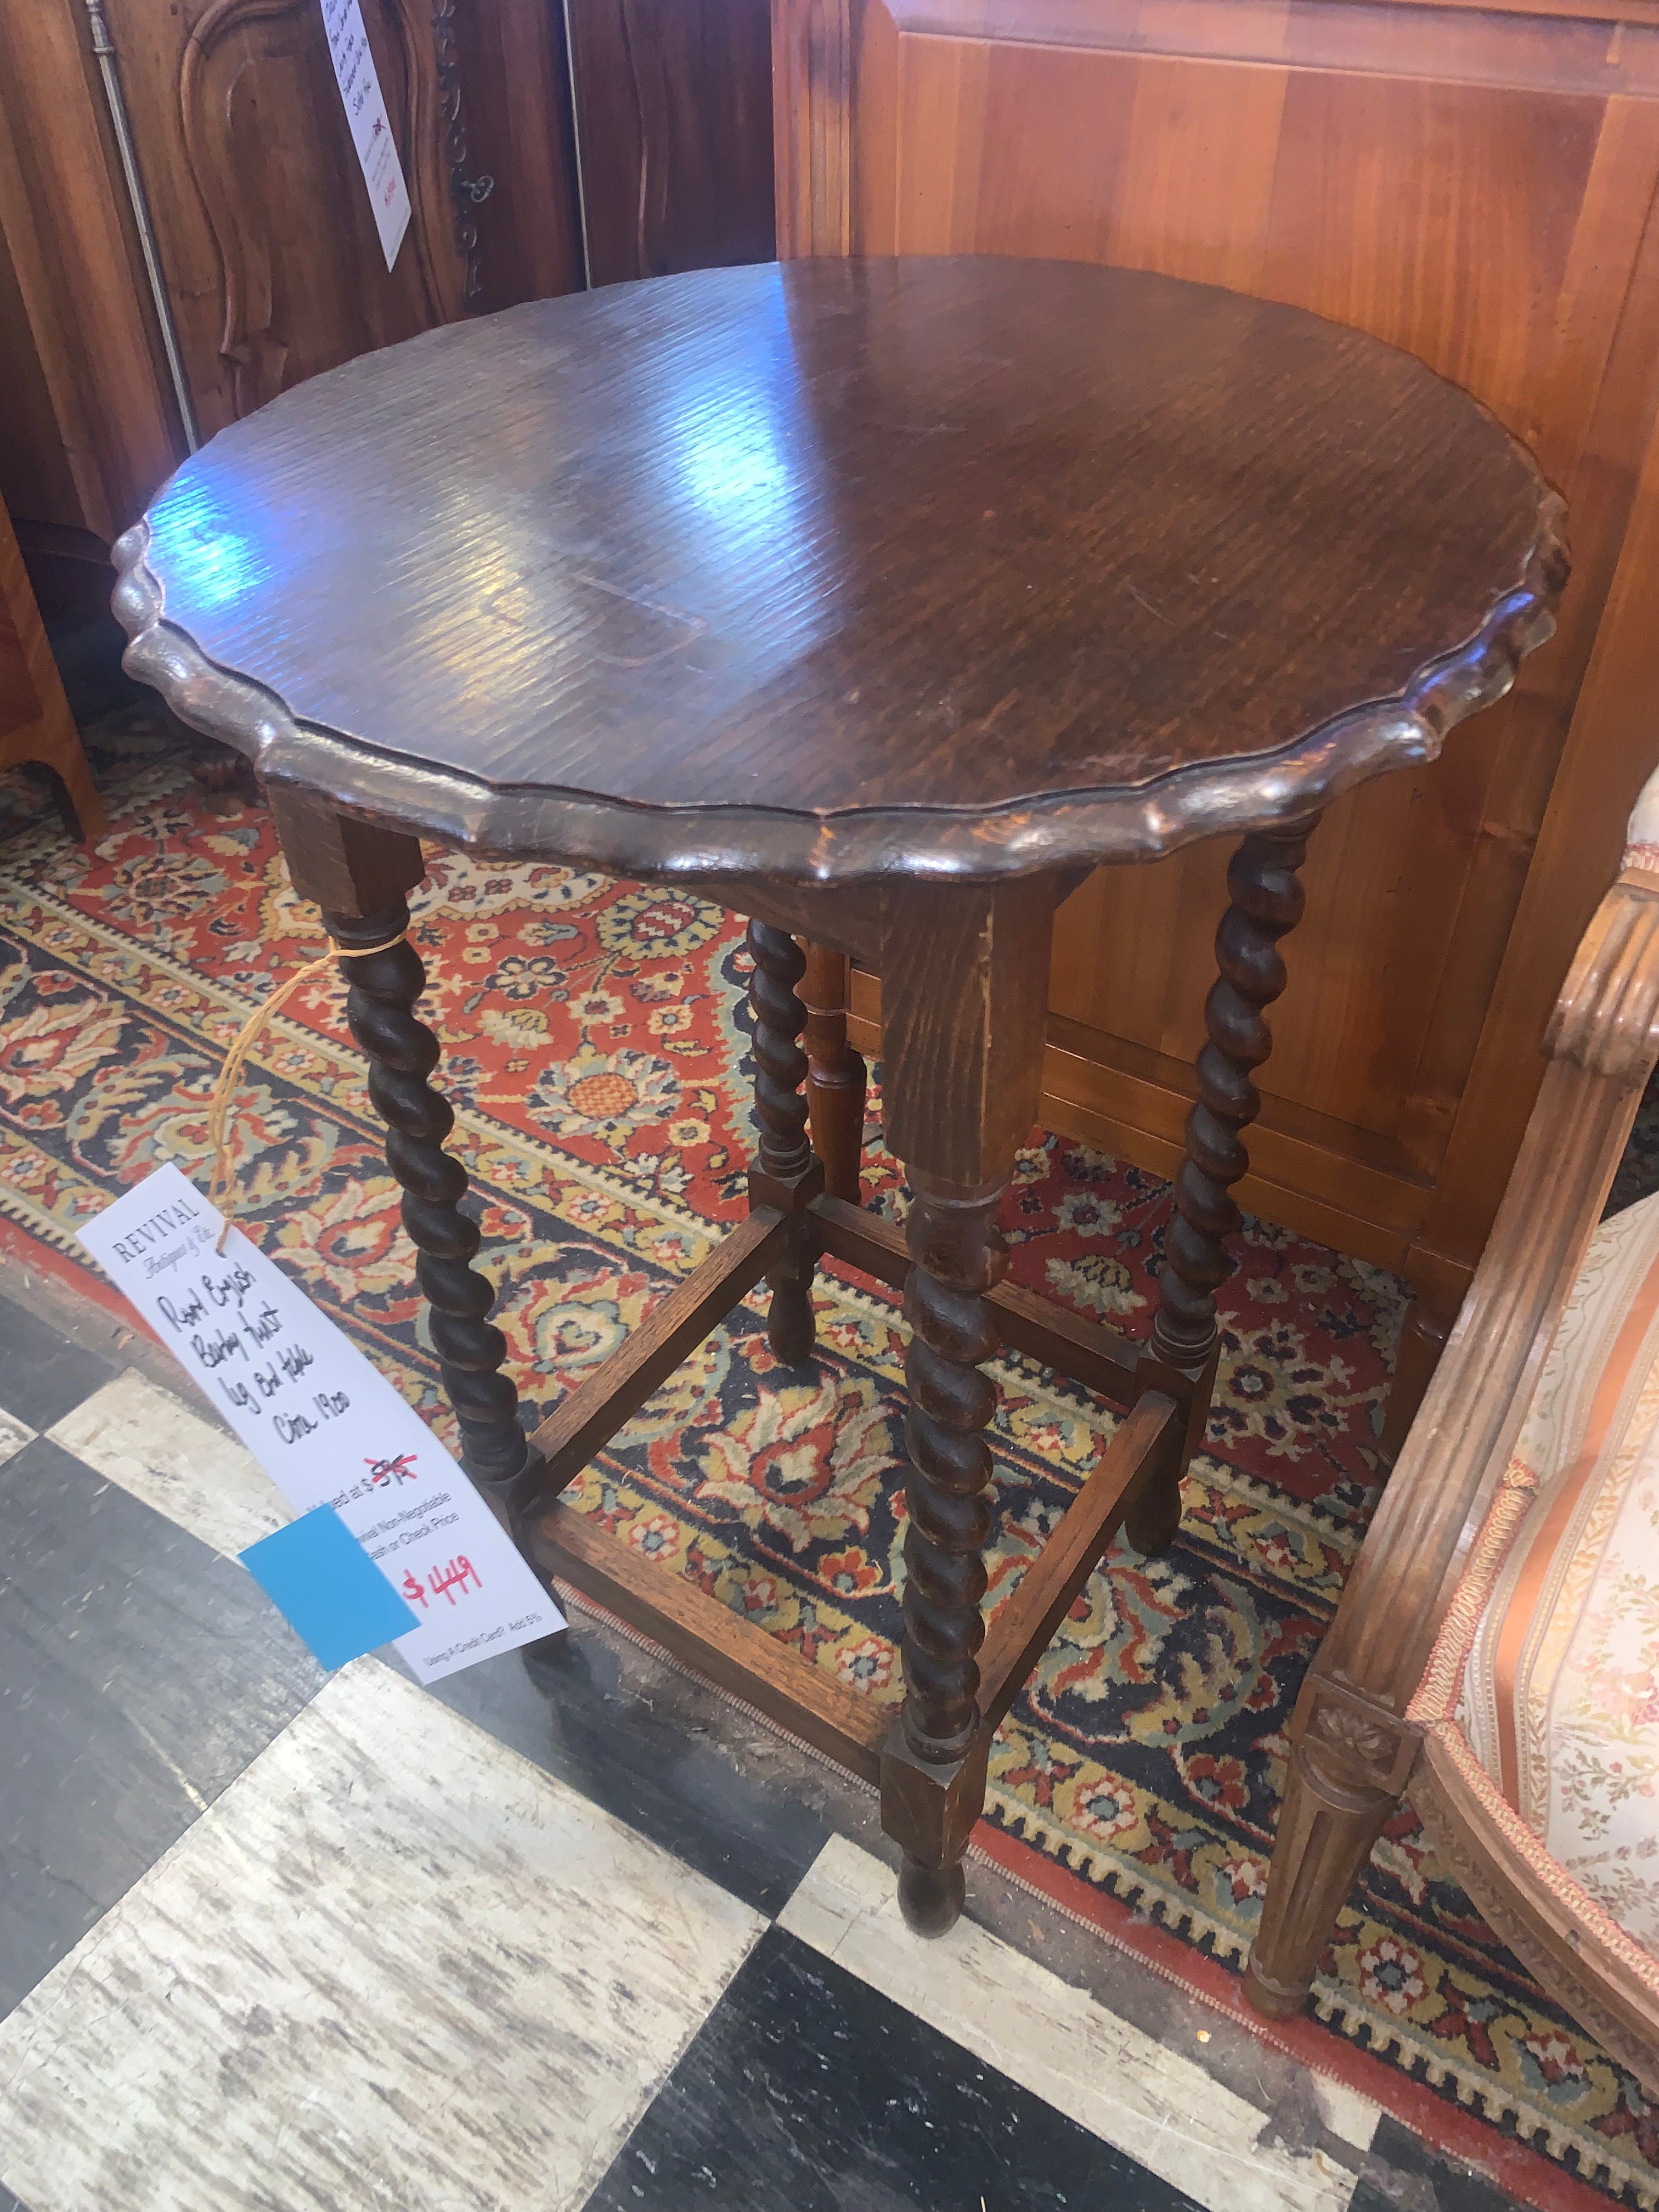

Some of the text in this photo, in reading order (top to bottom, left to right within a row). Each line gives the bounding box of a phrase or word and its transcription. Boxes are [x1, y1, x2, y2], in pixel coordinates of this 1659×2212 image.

[112, 1198, 200, 1263] REVIVAL
[312, 1391, 351, 1420] 1900
[349, 1485, 365, 1499] at
[377, 1492, 452, 1530] Non-Negotiable
[388, 1540, 400, 1551] or
[398, 1522, 435, 1544] Check
[430, 1511, 460, 1530] Price
